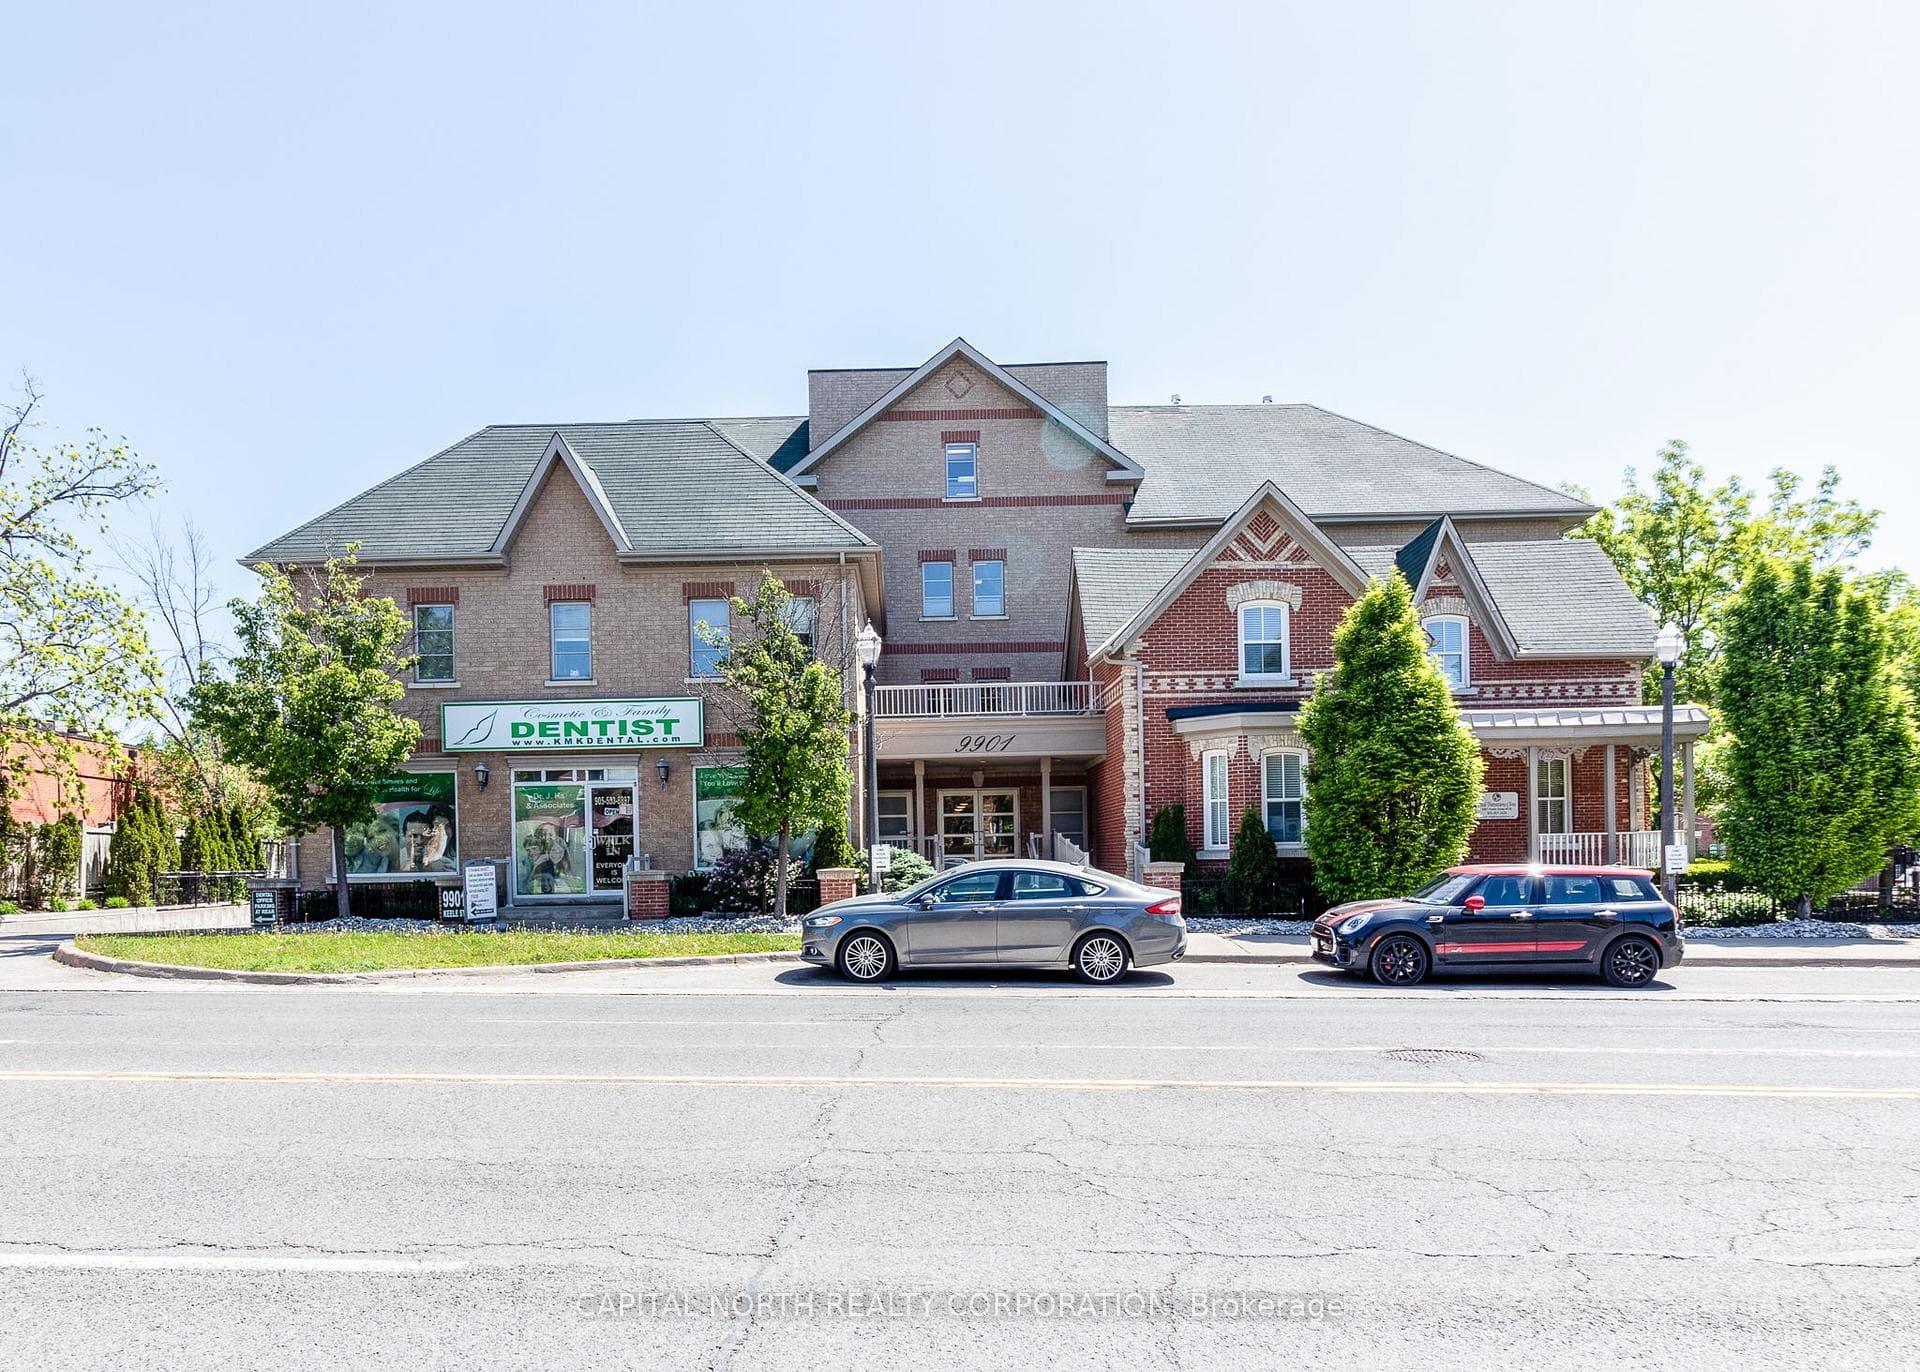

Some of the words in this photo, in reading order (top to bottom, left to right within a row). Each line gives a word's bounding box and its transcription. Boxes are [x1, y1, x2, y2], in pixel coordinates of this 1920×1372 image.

[520, 706, 585, 719] Cosmetic
[591, 706, 613, 718] &
[615, 704, 672, 719] Family
[511, 719, 680, 738] DENTIST
[512, 736, 681, 746] www.KMKDENTAL.com
[954, 734, 1017, 753] 9901
[443, 890, 464, 908] 9901
[443, 910, 459, 918] KEELE
